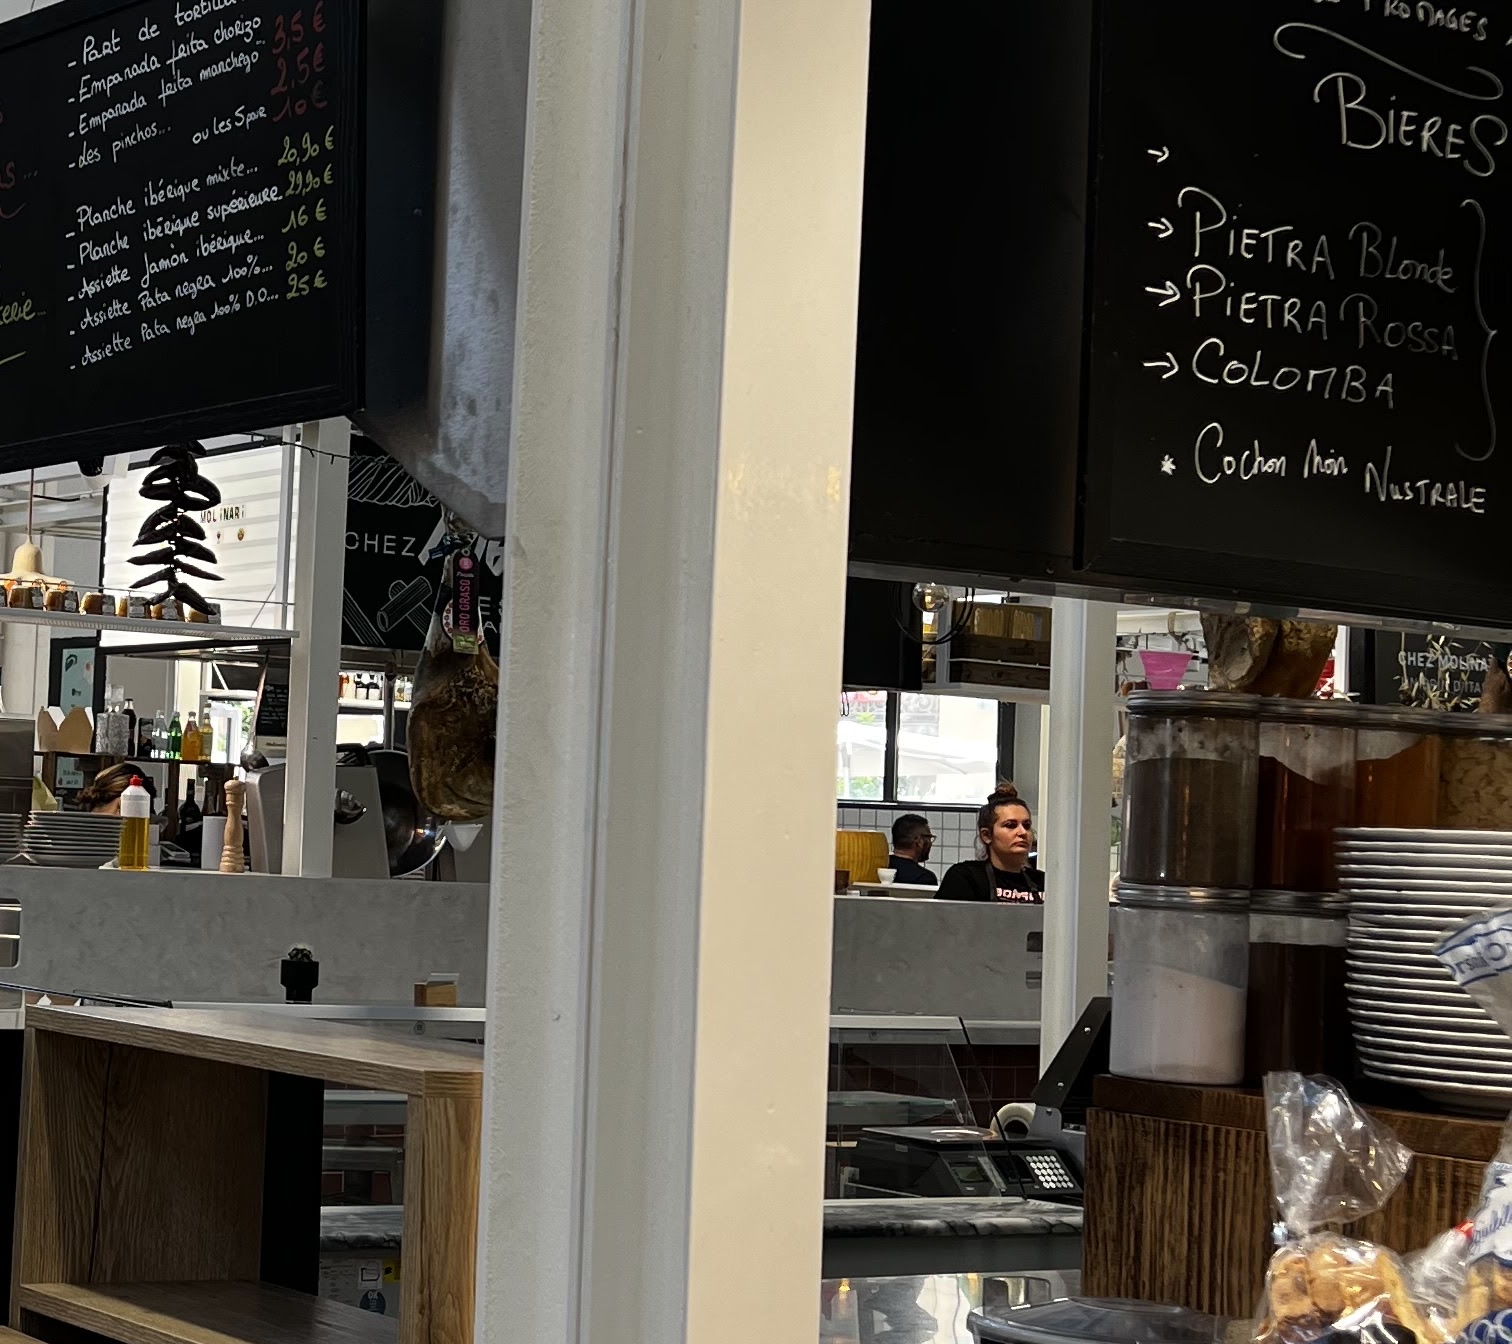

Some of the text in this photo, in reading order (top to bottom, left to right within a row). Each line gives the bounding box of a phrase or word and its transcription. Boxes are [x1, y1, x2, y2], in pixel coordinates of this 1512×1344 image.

[139, 17, 160, 41] de
[79, 53, 161, 103] Empanada
[79, 91, 147, 135] Empanada
[192, 128, 209, 144] ou
[76, 196, 136, 232] Planche
[144, 178, 201, 206] ibérique
[79, 231, 130, 265] Planche
[78, 264, 131, 299] Assiette
[80, 299, 132, 331] Assiette
[138, 287, 171, 312] Pata
[175, 274, 216, 300] negra
[81, 331, 133, 366] Assiette
[140, 318, 171, 342] Pata
[176, 310, 207, 336] negra
[1339, 293, 1459, 361] ROSSA
[1192, 337, 1394, 410] COLOMBA
[1195, 422, 1286, 484] Cochon
[345, 532, 416, 557] CHEZ
[459, 579, 471, 611] GRASO
